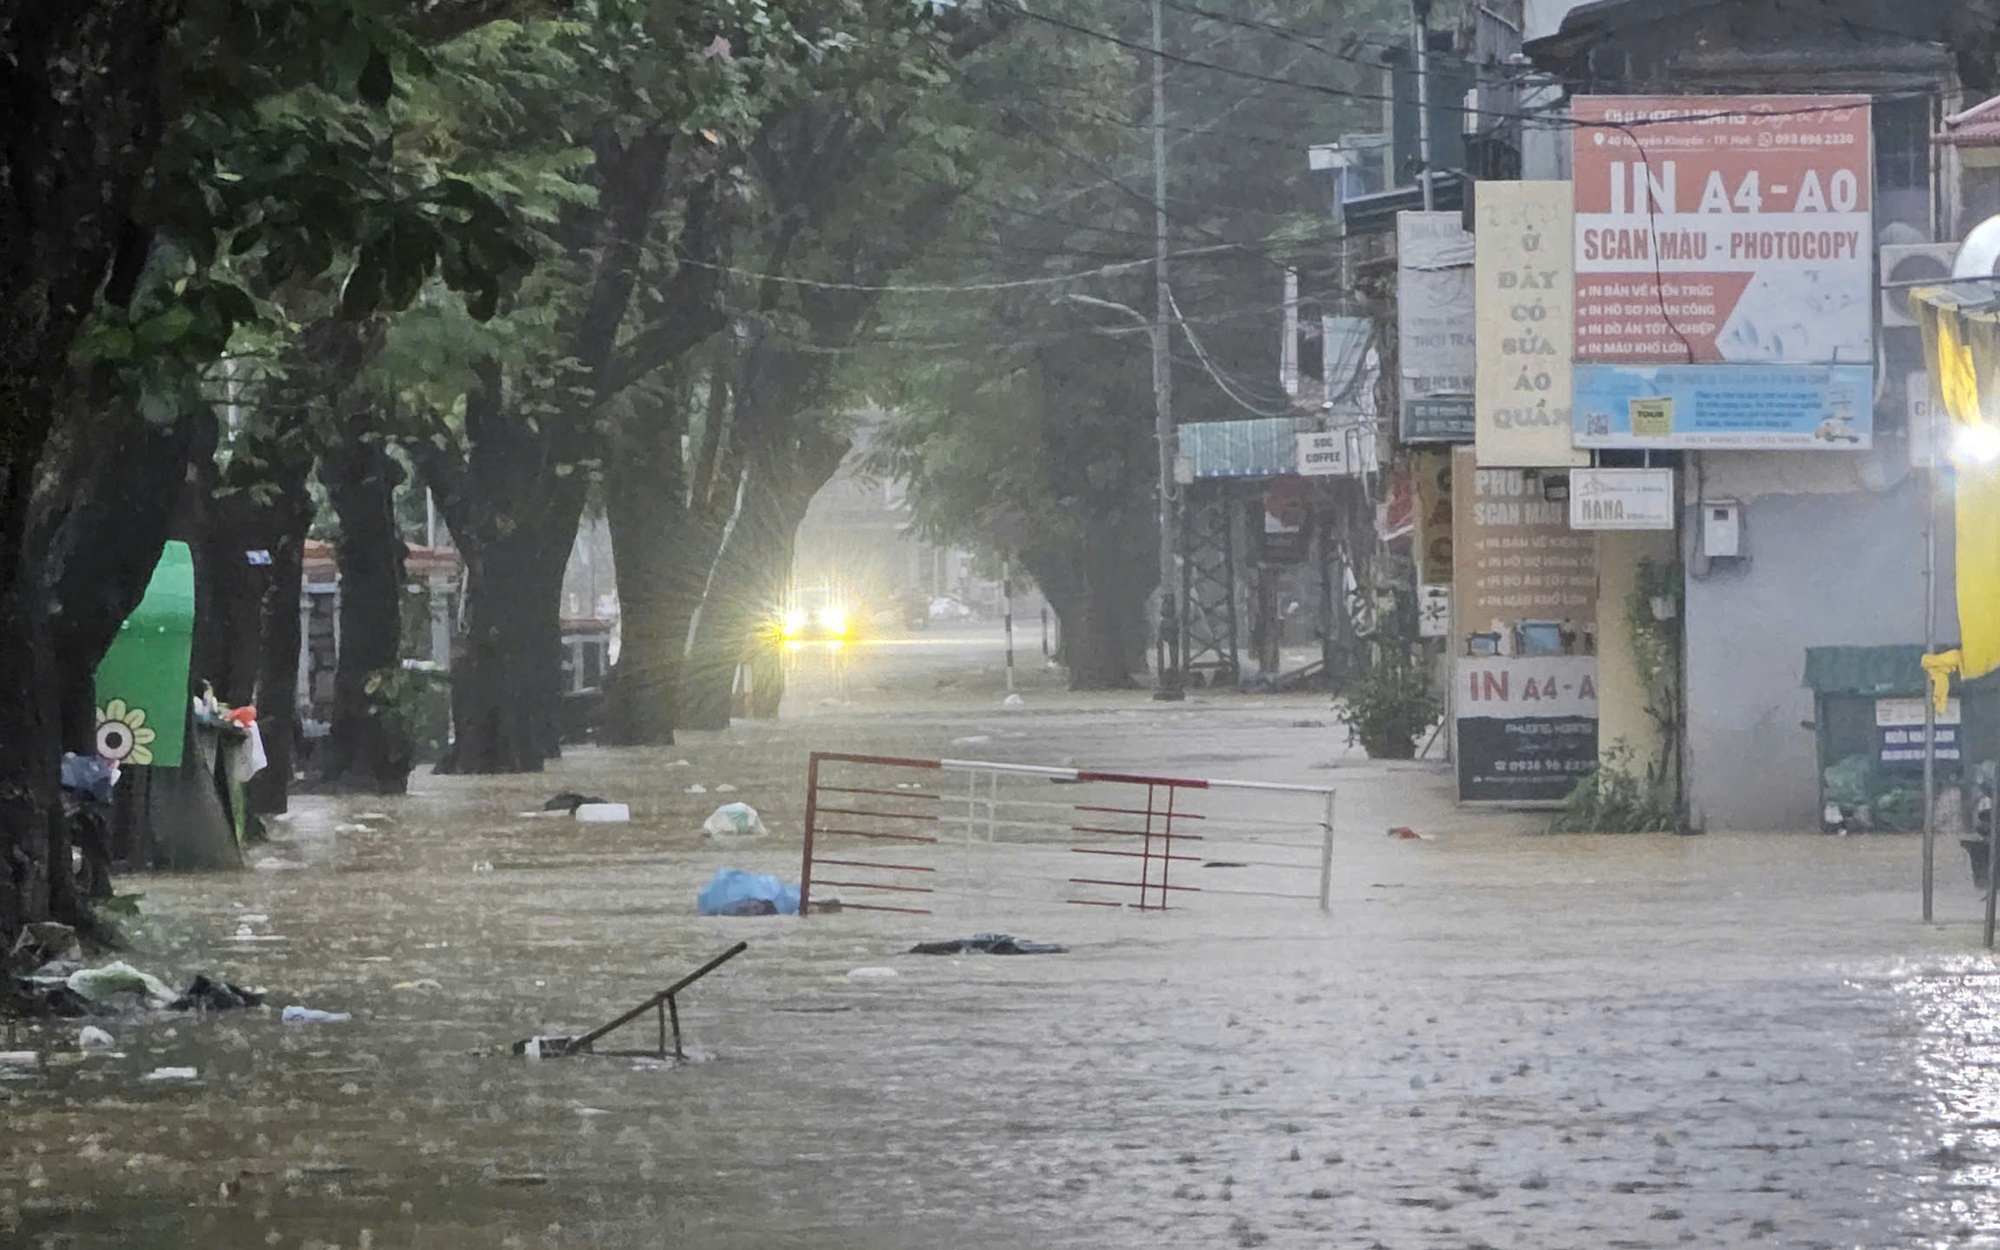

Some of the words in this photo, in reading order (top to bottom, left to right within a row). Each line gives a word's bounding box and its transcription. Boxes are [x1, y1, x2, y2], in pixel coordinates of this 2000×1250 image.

[1610, 161, 1677, 214] IN
[1584, 228, 1648, 261] SCAN
[1659, 227, 1707, 260] MÀU
[1730, 230, 1859, 260] PHOTOCOPY
[1498, 265, 1558, 289] ĐÂY
[1588, 285, 1602, 296] IN
[1511, 298, 1546, 322] CÓ
[1588, 304, 1602, 315] IN
[1682, 302, 1715, 316] CÔNG
[1588, 323, 1602, 334] IN
[1502, 328, 1556, 355] SỬA
[1588, 342, 1602, 353] IN
[1513, 365, 1552, 391] ÁO
[1305, 451, 1341, 464] COFFEE
[1474, 502, 1520, 526] SCAN
[1470, 670, 1509, 702] IN
